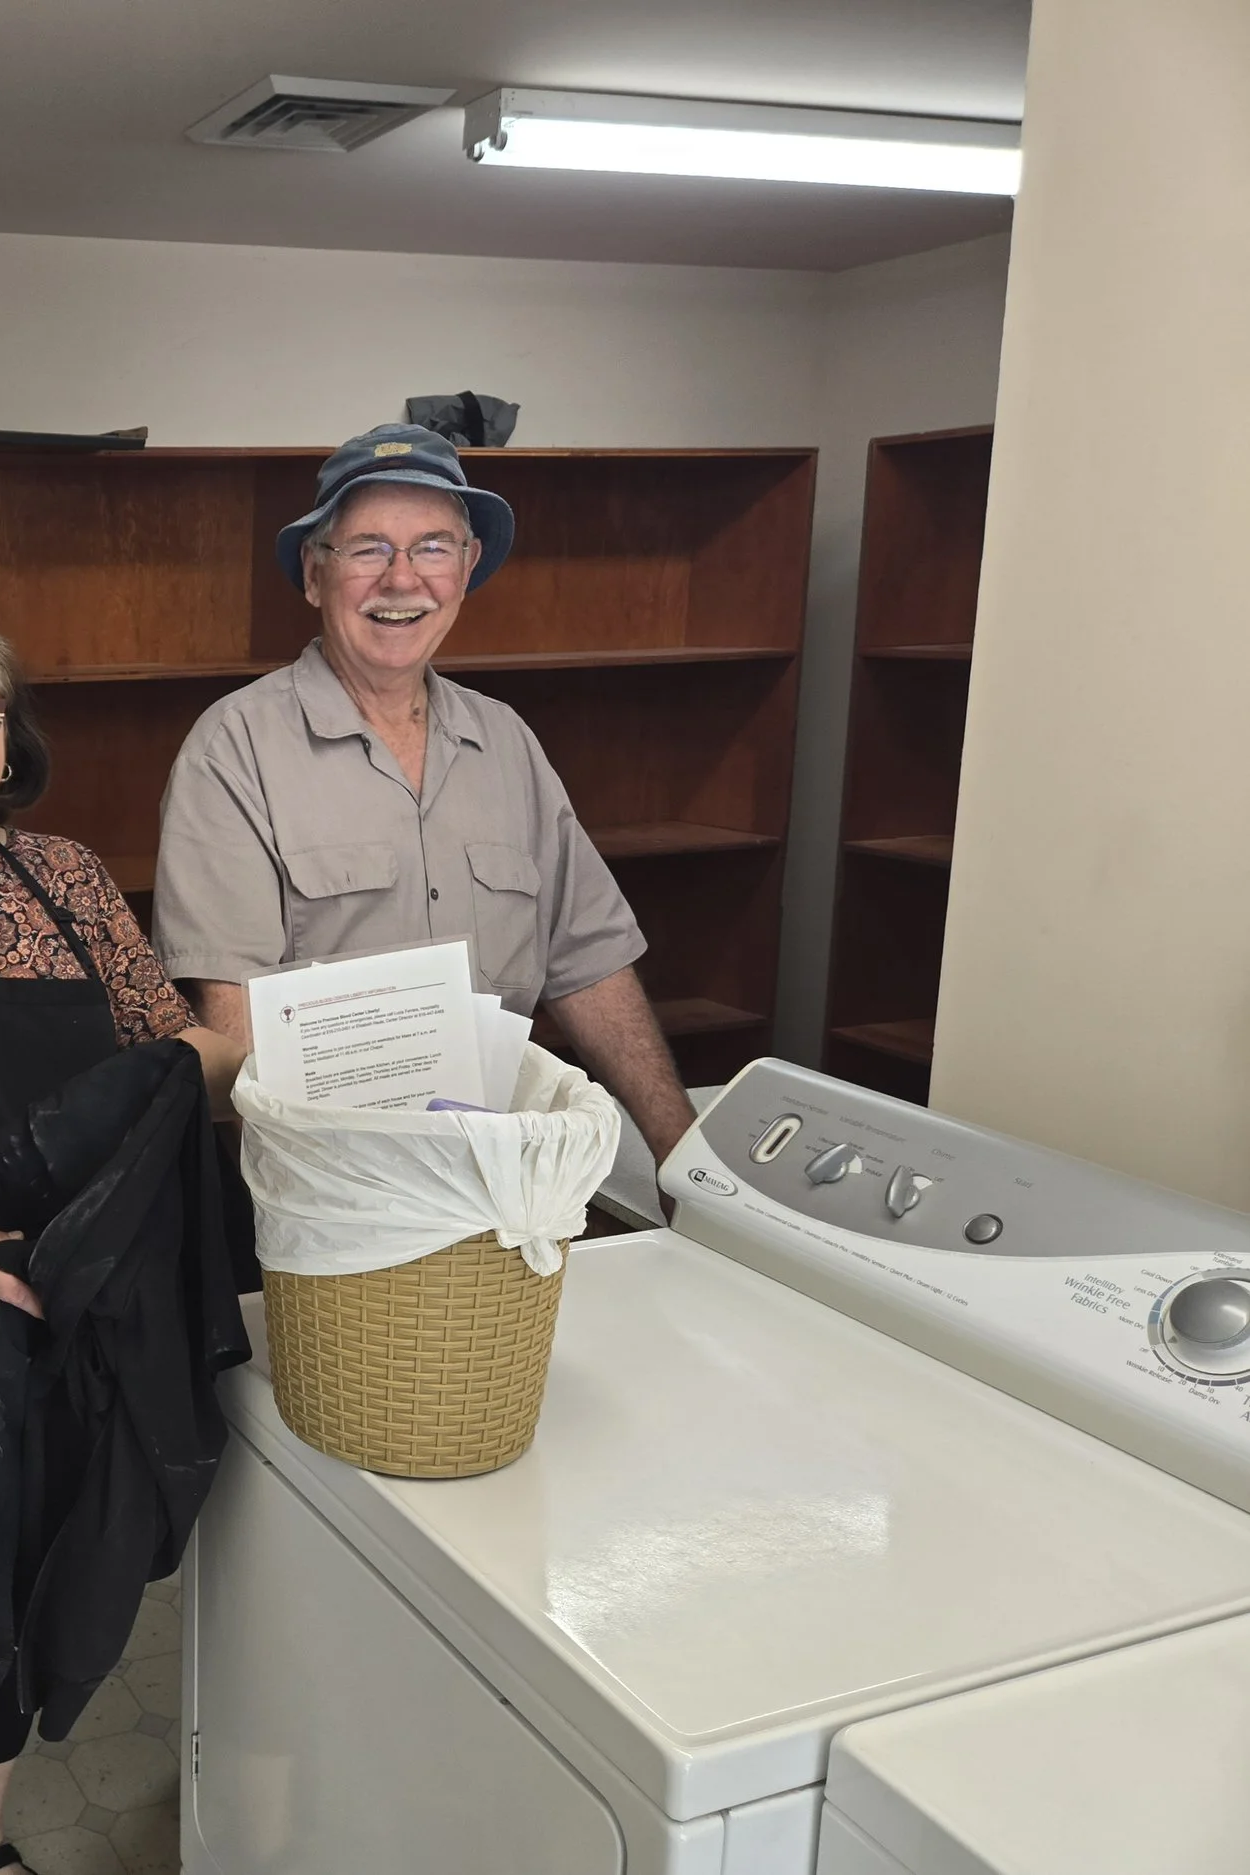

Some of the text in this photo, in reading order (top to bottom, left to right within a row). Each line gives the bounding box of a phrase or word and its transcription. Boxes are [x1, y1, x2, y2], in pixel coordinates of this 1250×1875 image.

[1084, 1274, 1125, 1294] IntelliDry
[1155, 1274, 1173, 1284] Down
[1064, 1276, 1131, 1310] Wrinkle Free
[1070, 1293, 1109, 1314] Fabrics
[1188, 1387, 1207, 1400] Damp
